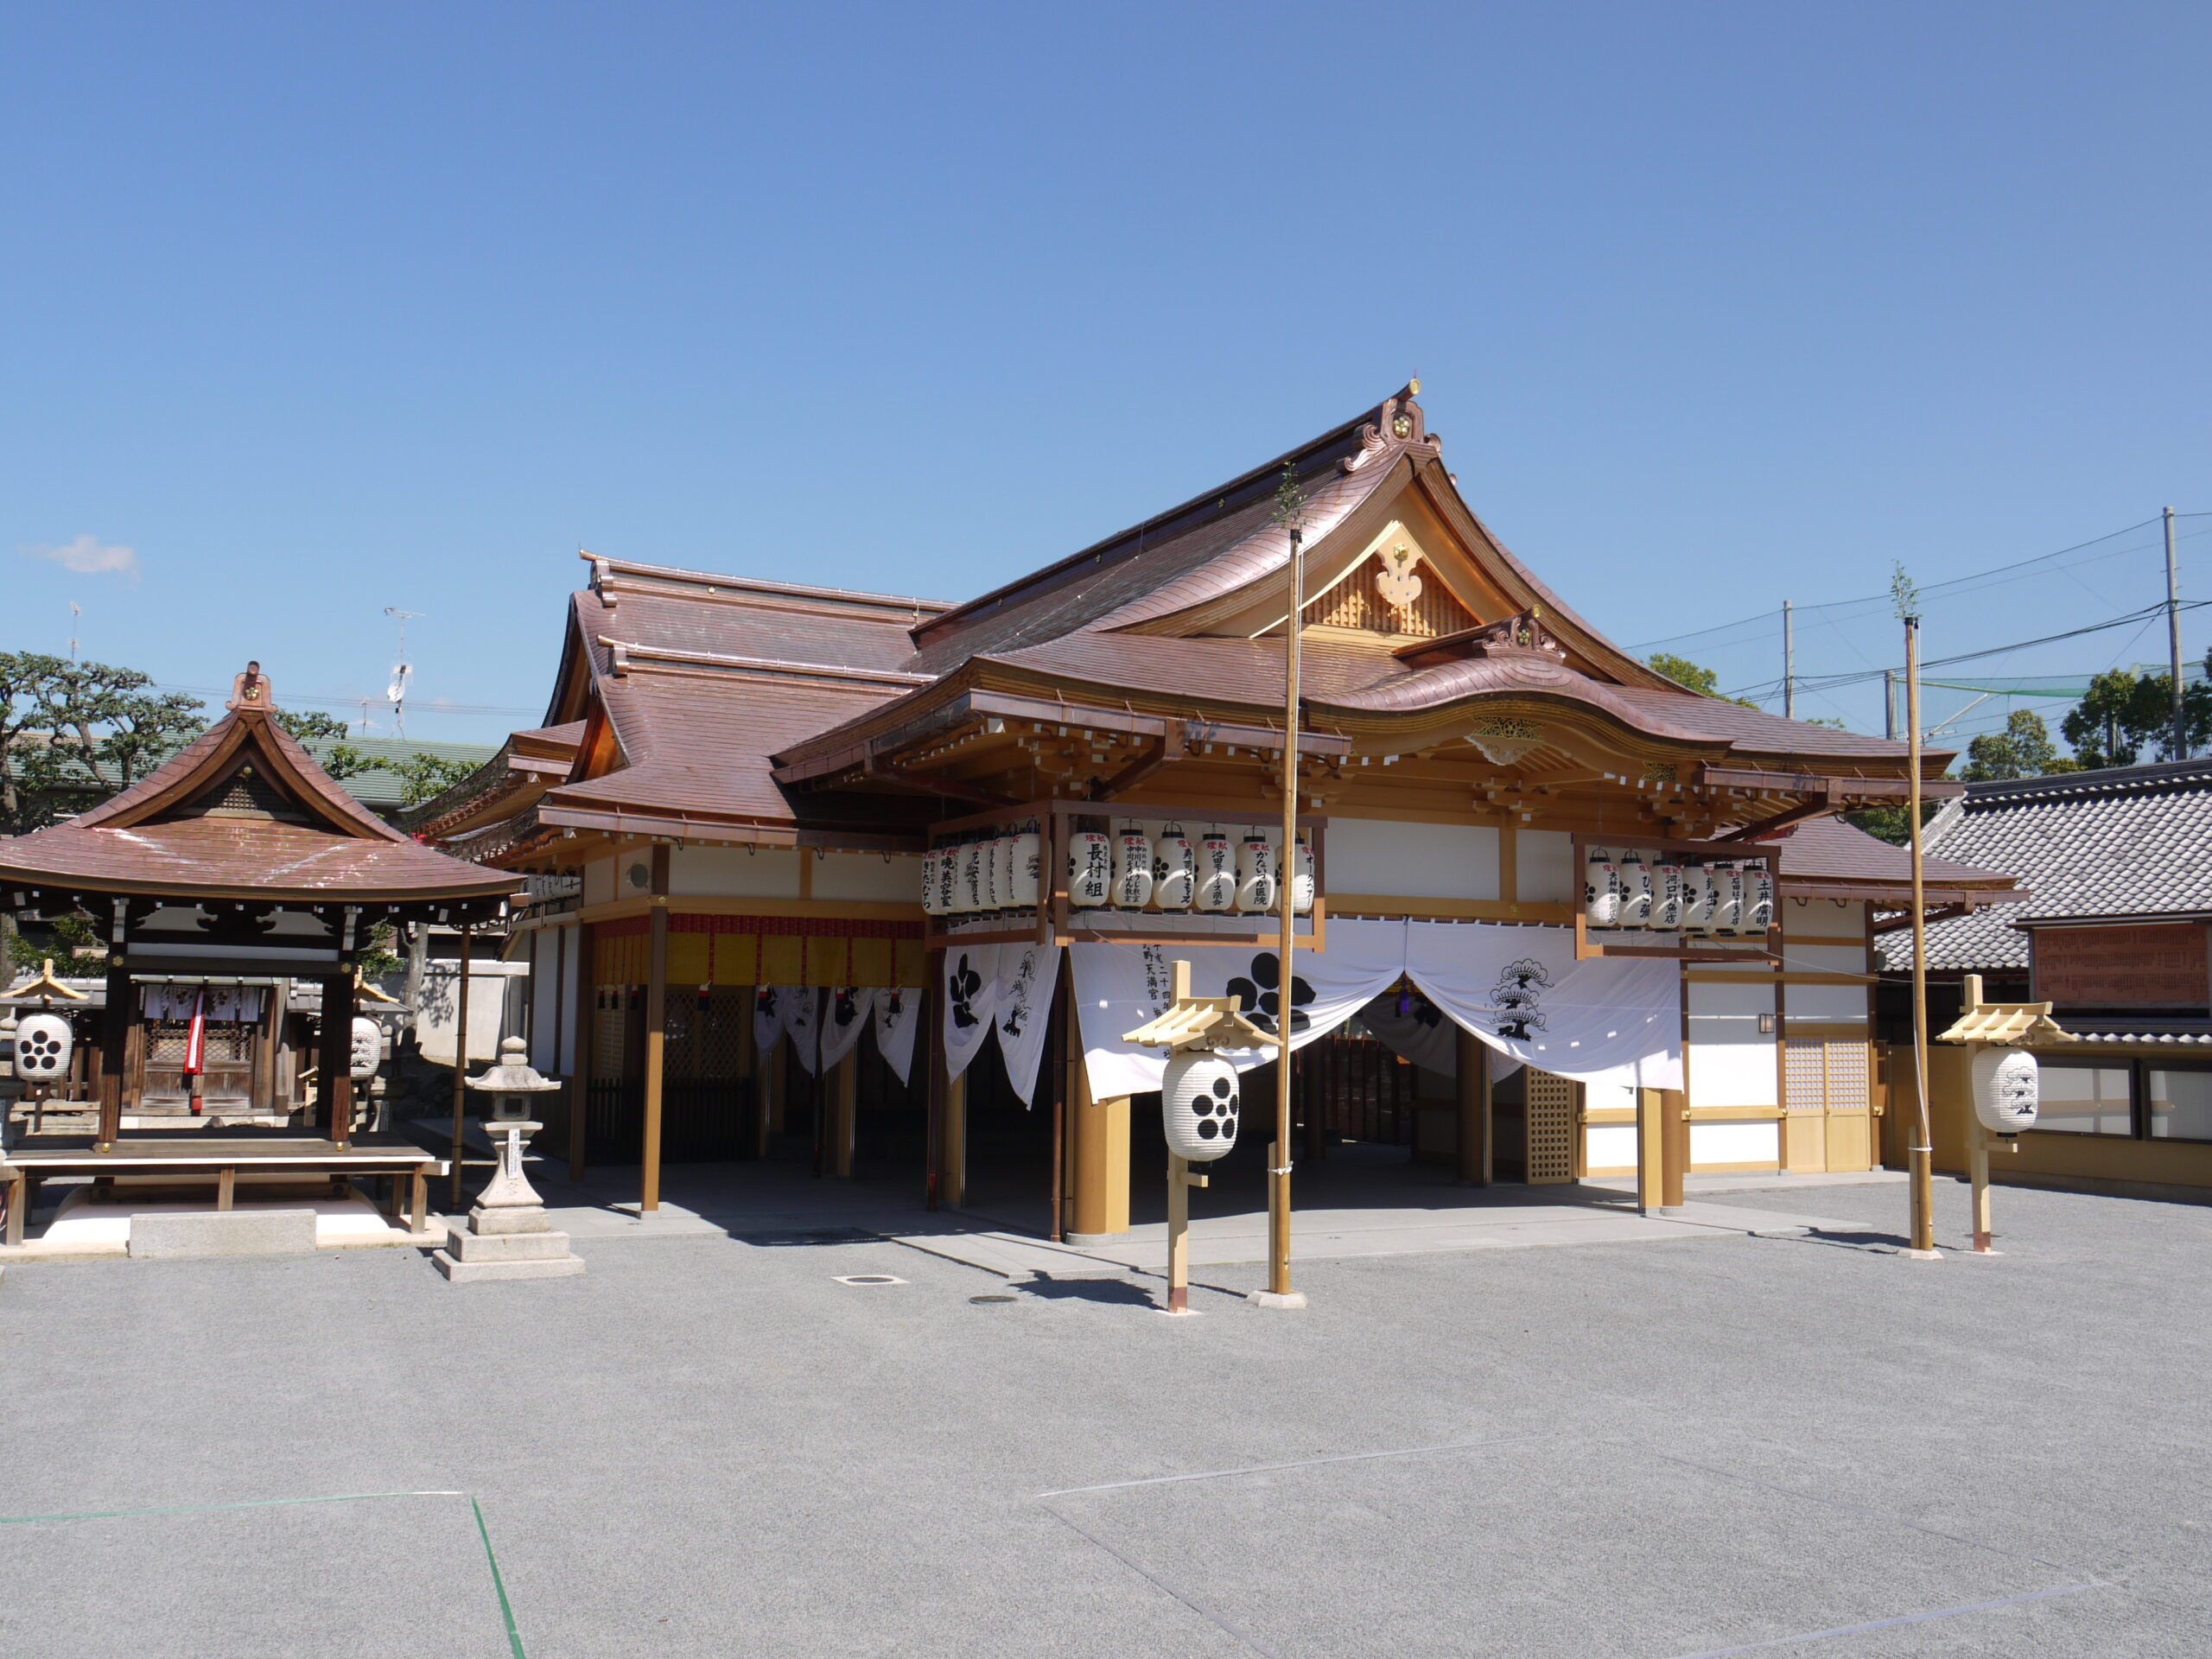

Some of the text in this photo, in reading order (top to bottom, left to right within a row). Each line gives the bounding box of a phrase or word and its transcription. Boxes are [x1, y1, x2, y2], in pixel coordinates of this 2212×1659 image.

[1085, 843, 1103, 897] 長村組
[1665, 874, 1677, 925] 河口鮮魚店
